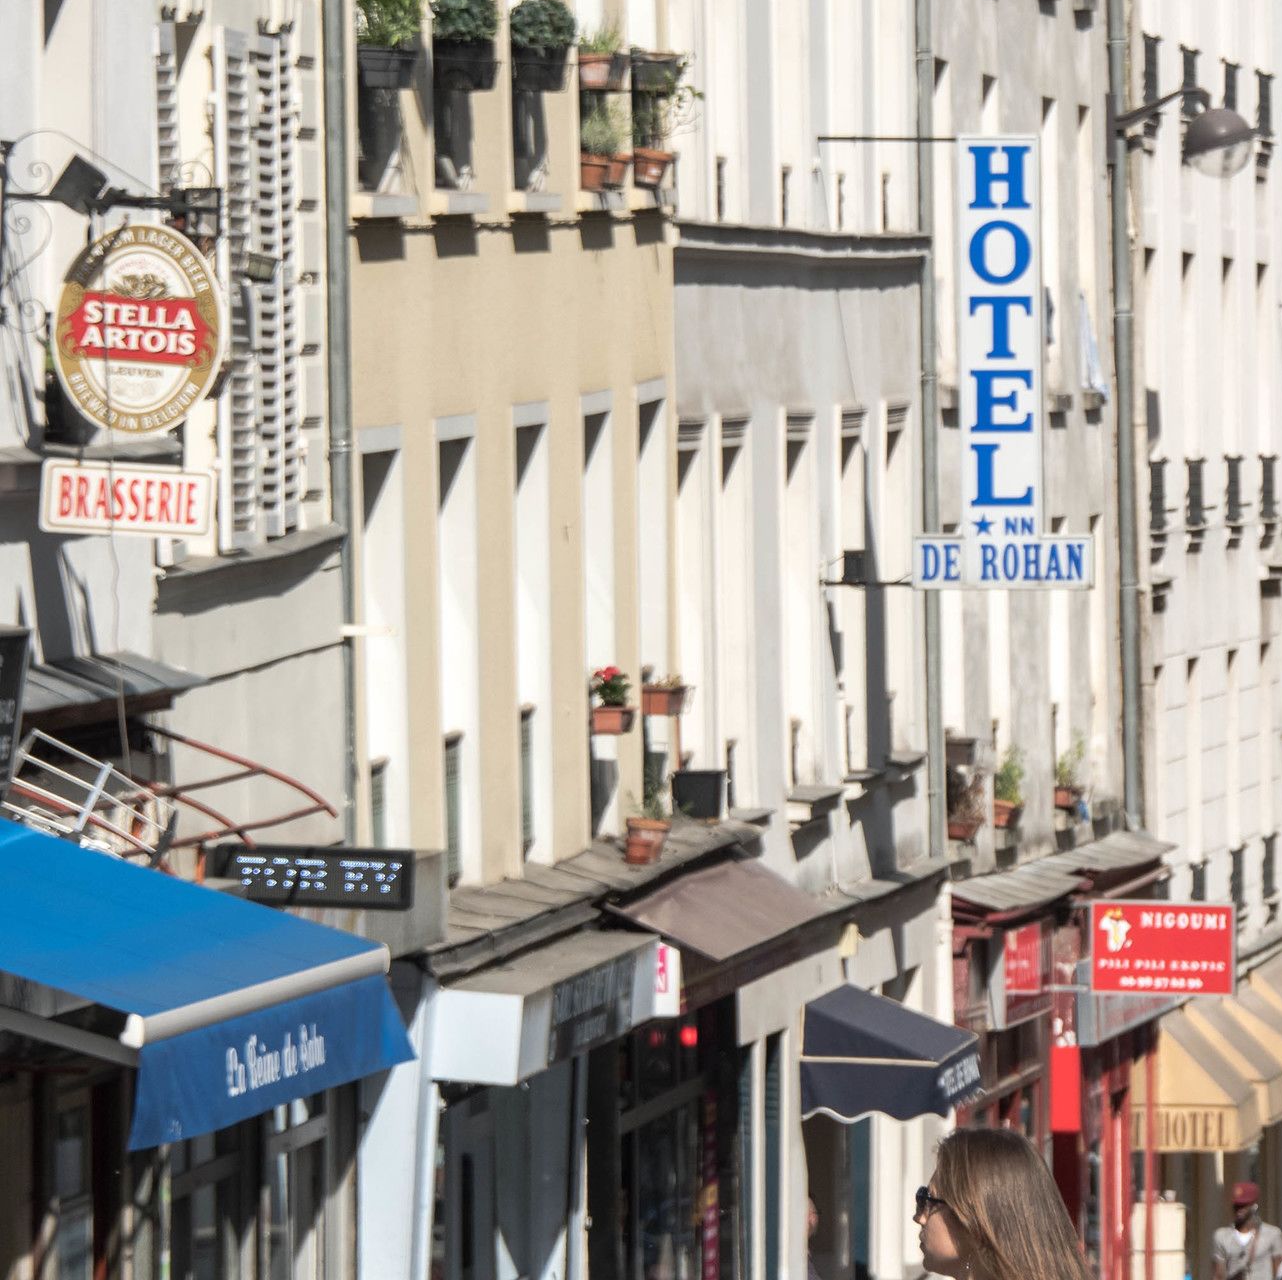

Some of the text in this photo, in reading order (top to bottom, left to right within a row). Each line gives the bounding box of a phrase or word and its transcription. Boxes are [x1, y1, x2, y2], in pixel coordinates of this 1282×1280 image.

[138, 229, 185, 258] LAGER
[180, 253, 210, 294] BEER
[83, 300, 197, 331] STELLA
[968, 145, 1034, 507] HOTEL
[80, 325, 196, 356] ARTOIS
[68, 372, 118, 423] BREWED
[140, 381, 200, 430] BELGIUM
[58, 474, 198, 526] BRASSERIE
[1005, 517, 1034, 535] NN
[921, 543, 1085, 581] DE ROHAN
[282, 1031, 298, 1079] de
[1157, 1111, 1230, 1147] HOTEL
